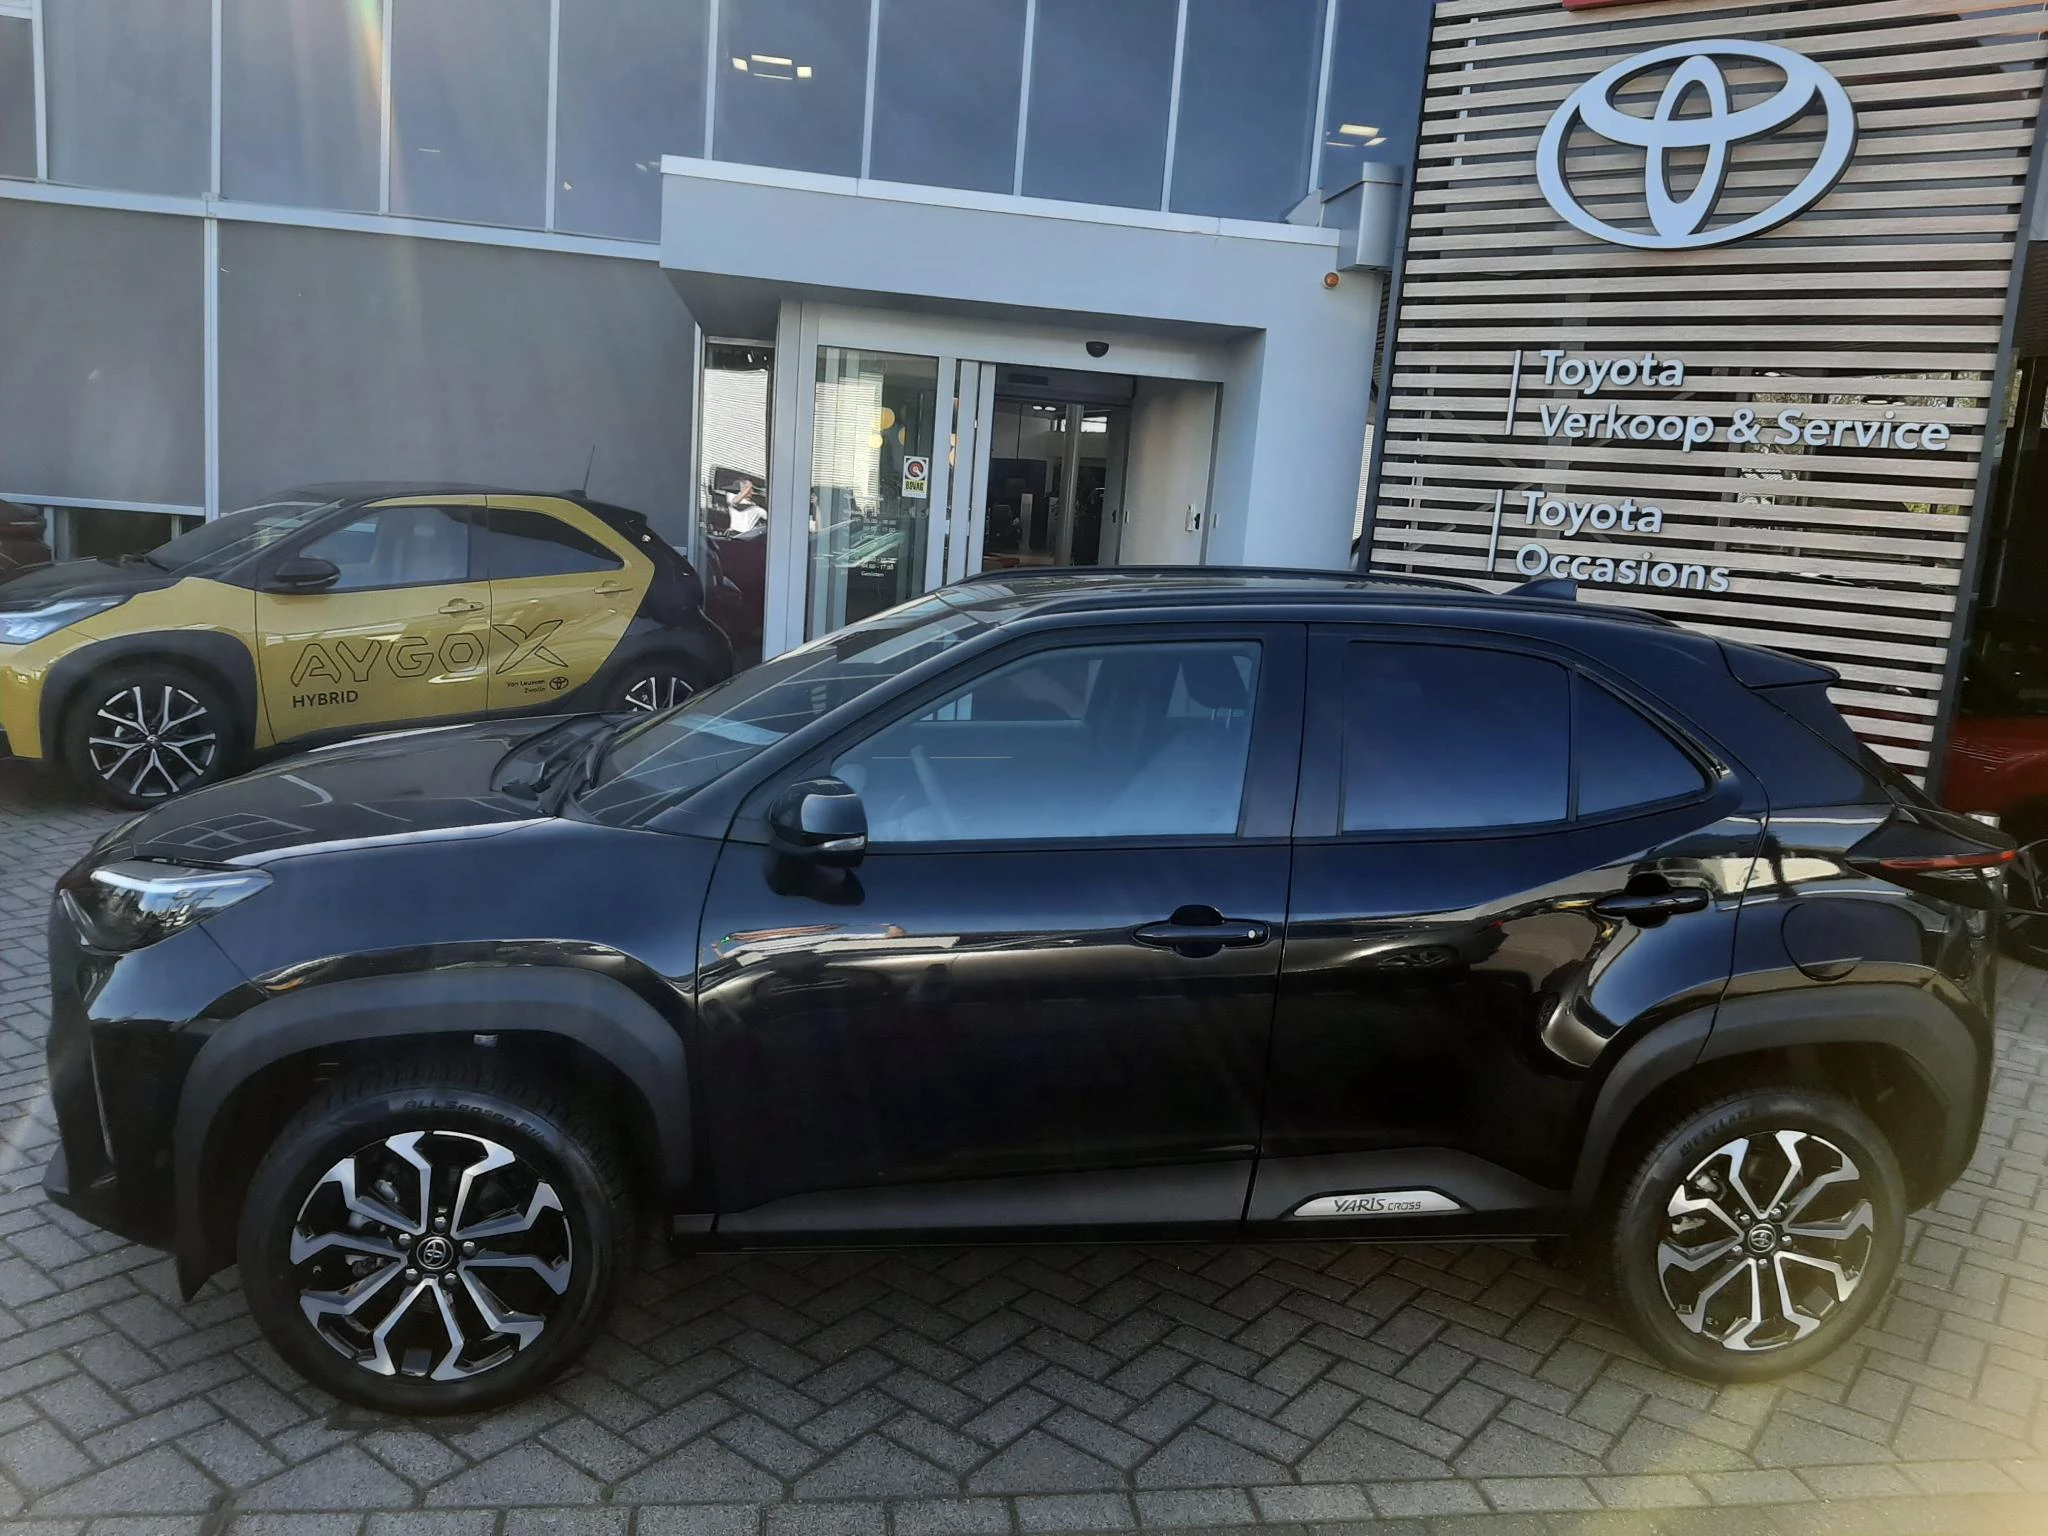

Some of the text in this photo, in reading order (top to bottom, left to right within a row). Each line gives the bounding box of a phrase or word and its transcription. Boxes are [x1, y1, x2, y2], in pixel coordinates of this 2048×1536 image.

[1540, 349, 1686, 395] Toyota
[1539, 403, 1951, 452] Verkoop & Service
[1521, 490, 1664, 537] Toyota
[1515, 543, 1731, 593] Occasions
[290, 632, 485, 688] AYGO
[292, 689, 359, 709] HYBRID
[1333, 1197, 1422, 1213] YARIS CROSS
